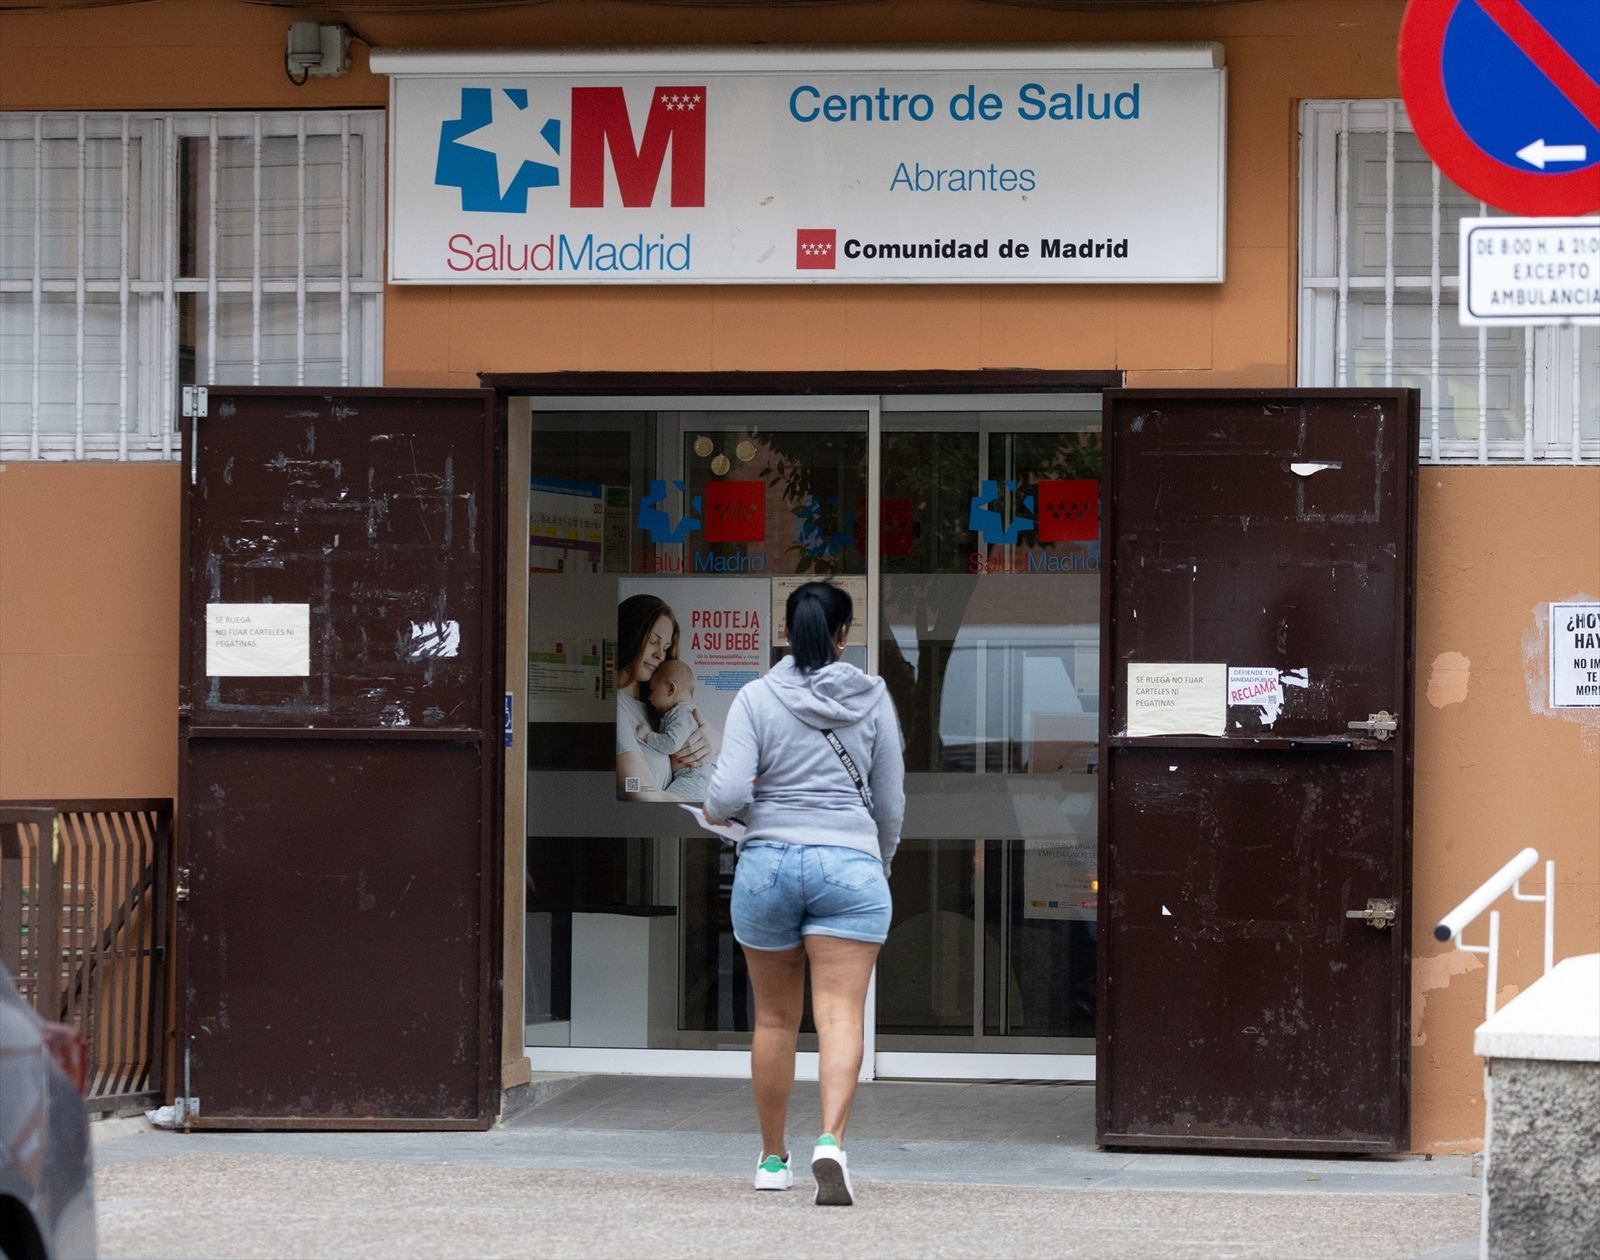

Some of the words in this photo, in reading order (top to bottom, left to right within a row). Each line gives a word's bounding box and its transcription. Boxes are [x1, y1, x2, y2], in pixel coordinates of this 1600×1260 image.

[789, 85, 934, 122] Centro
[950, 84, 1003, 121] de
[1017, 83, 1140, 120] Salud
[890, 162, 1036, 192] Abrantes
[843, 239, 989, 259] Comunidad
[998, 239, 1029, 258] de
[1040, 238, 1128, 258] Madrid
[1478, 239, 1493, 255] DE
[1557, 238, 1565, 253] A
[1513, 263, 1590, 280] EXCEPTO
[692, 610, 760, 629] PROTEJA
[691, 633, 701, 650] A
[704, 633, 722, 650] SU
[725, 629, 760, 651] BEBÉ
[1573, 658, 1587, 669] NO
[1135, 676, 1144, 684] SE
[1145, 676, 1170, 684] RUEGA
[1184, 676, 1203, 684] FIJAR
[1586, 671, 1598, 682] TE
[1135, 687, 1170, 695] CARTELES
[1231, 681, 1277, 702] RECLAMA
[826, 732, 844, 754] YOUNG
[841, 754, 860, 782] FOREVER
